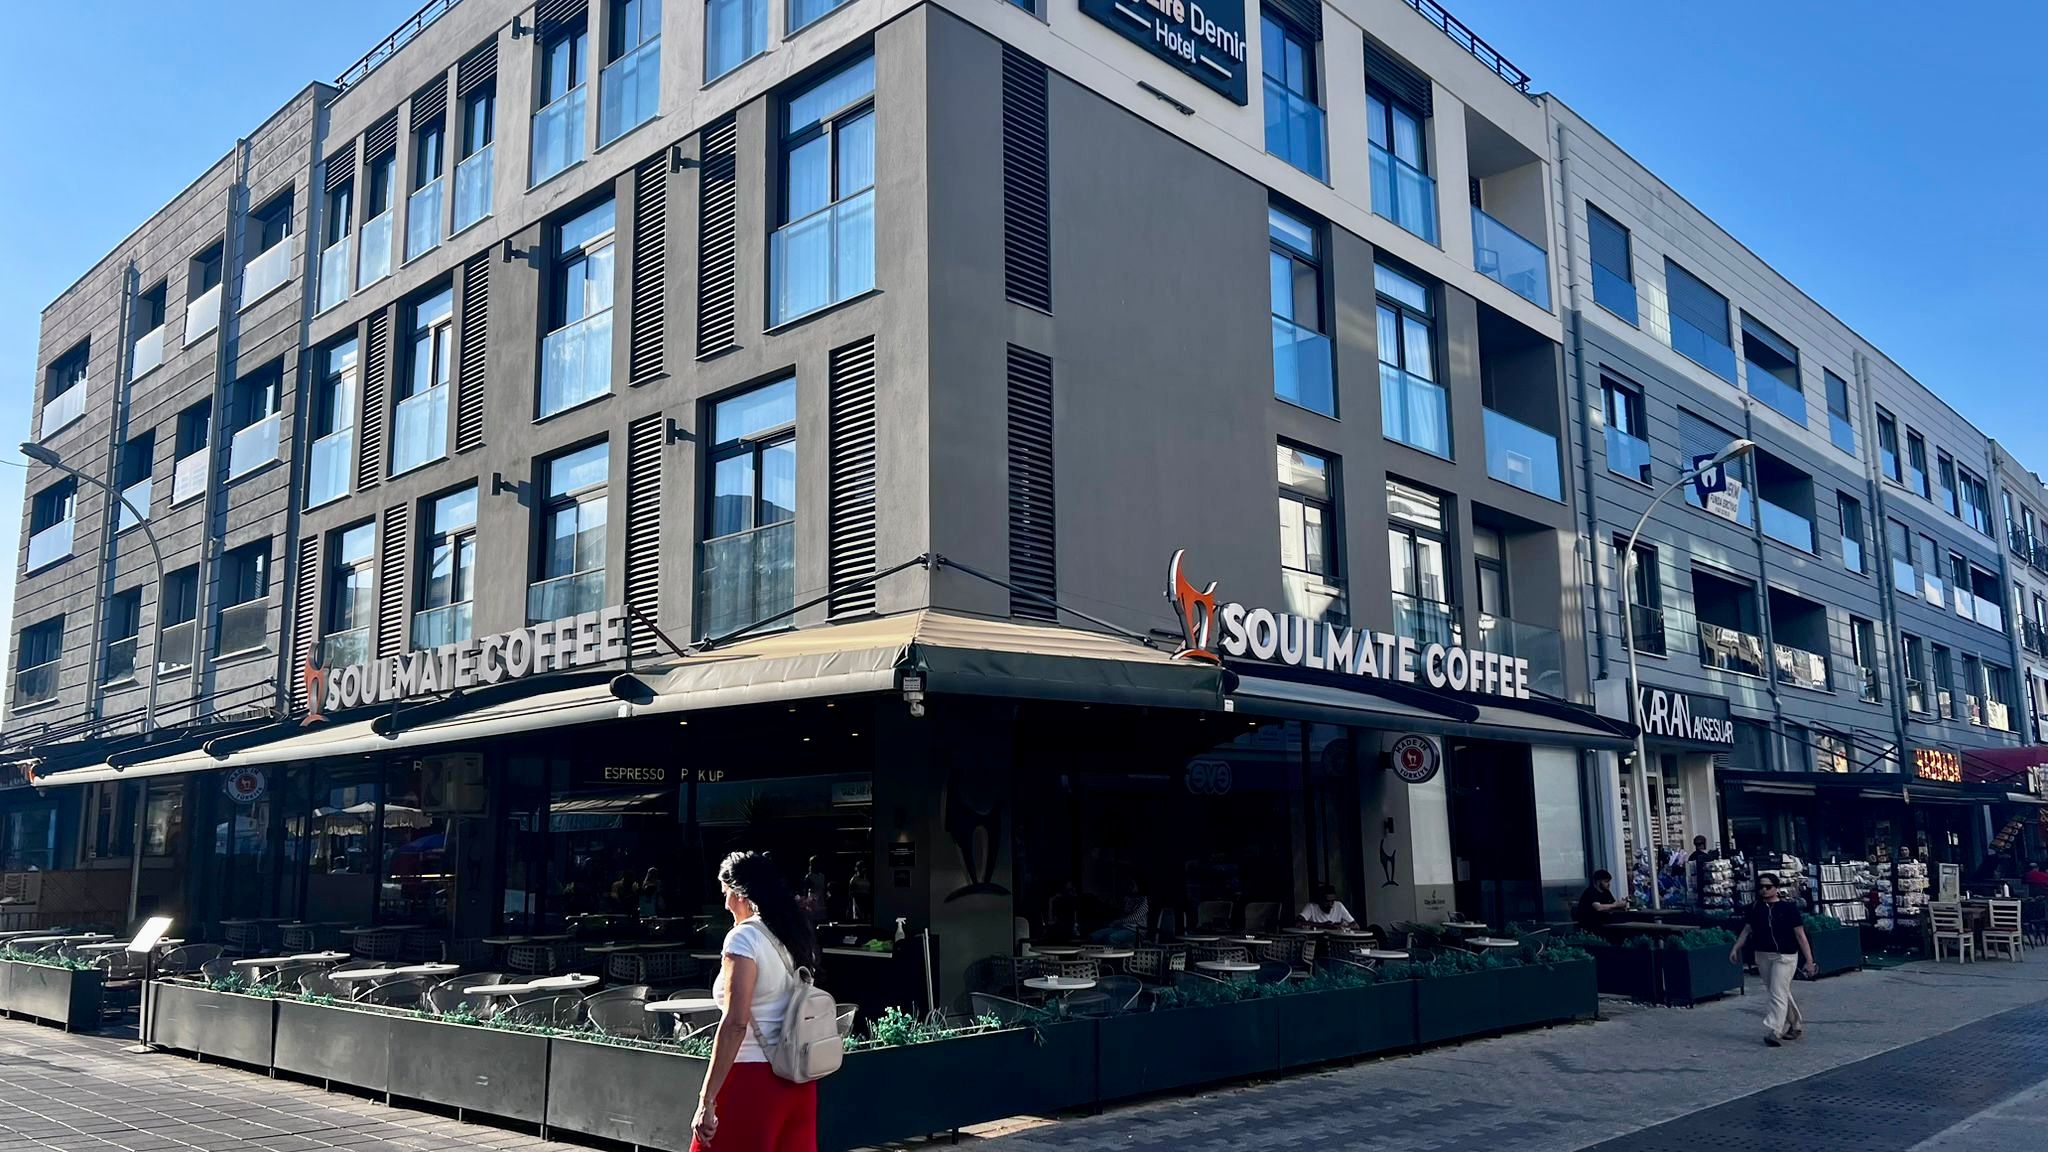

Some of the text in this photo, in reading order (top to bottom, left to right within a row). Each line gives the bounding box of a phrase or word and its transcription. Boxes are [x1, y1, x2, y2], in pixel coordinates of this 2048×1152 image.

[1155, 18, 1197, 64] Hotel
[1190, 2, 1247, 63] Demir
[326, 604, 628, 711] SOULMATE COFFEE
[1219, 602, 1530, 700] SOULMATE COFFEE
[1639, 686, 1735, 744] KARAN AKSESUAR
[604, 767, 665, 781] ESPRESSO
[1395, 739, 1428, 754] MADE IN
